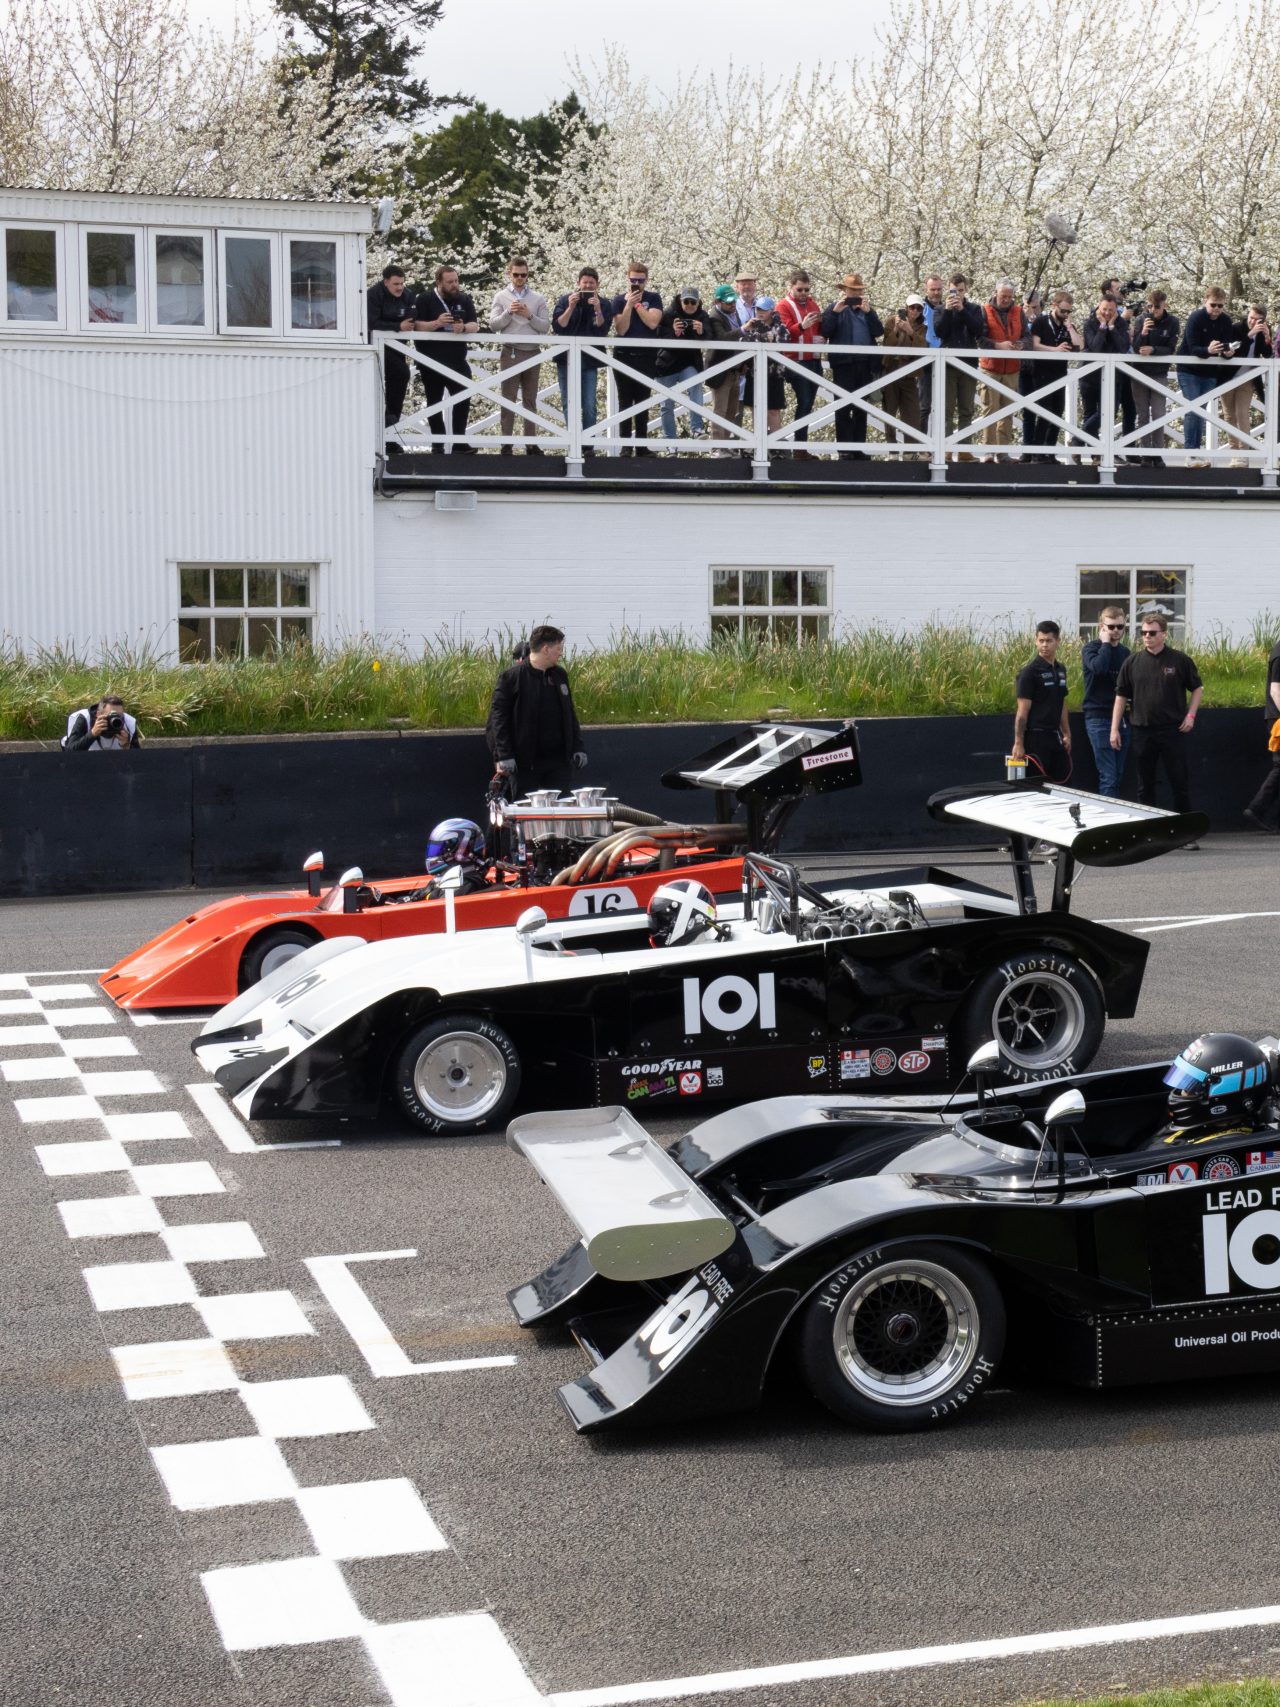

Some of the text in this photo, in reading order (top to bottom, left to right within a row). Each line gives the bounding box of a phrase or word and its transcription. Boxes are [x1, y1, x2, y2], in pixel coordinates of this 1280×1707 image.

[806, 751, 849, 768] Firestone
[584, 893, 621, 914] 16
[999, 954, 1075, 986] Hoosier
[683, 972, 777, 1035] 101
[477, 1023, 518, 1069] Hoosier
[621, 1058, 702, 1076] GOODYEAR
[812, 1059, 823, 1068] BP
[903, 1053, 926, 1069] STP
[1003, 1057, 1077, 1083] Hoosier
[1210, 1061, 1244, 1075] MILLER
[402, 1086, 447, 1133] Hoosier
[1229, 1161, 1239, 1175] CLUB
[1206, 1189, 1263, 1211] LEAD
[699, 1261, 734, 1304] LEAD FREE
[817, 1249, 883, 1313] Hoosier
[639, 1274, 720, 1372] 101
[1174, 1333, 1227, 1348] Universal
[1231, 1330, 1247, 1343] Oil
[931, 1355, 994, 1419] Hoosier
